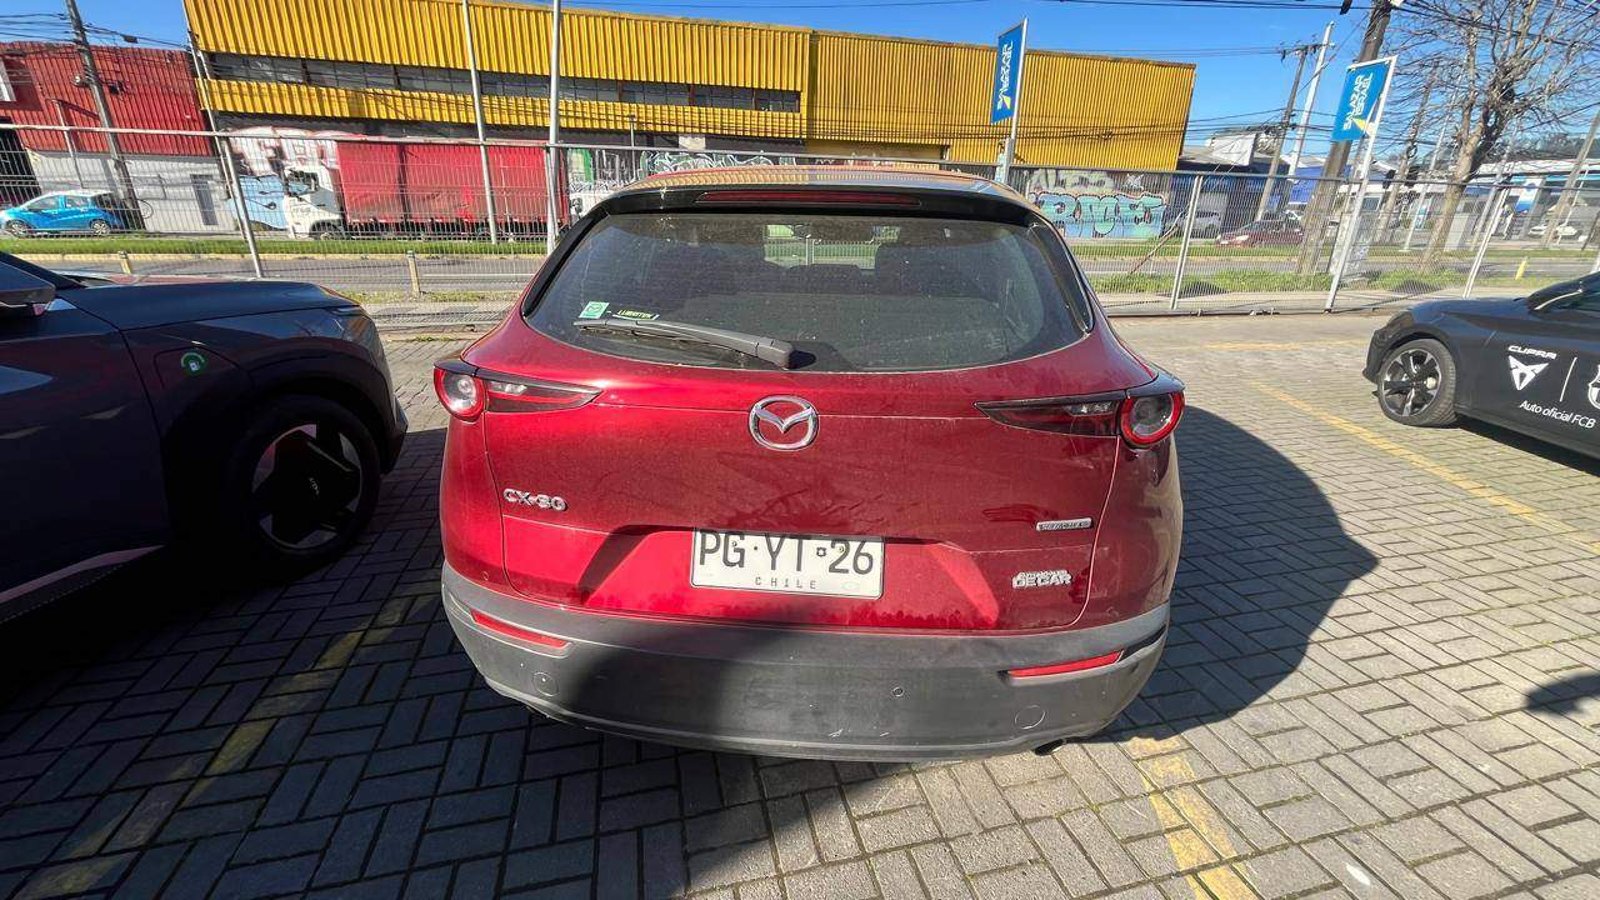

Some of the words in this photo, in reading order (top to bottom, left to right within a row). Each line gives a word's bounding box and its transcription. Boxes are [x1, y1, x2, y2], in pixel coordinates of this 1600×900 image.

[1519, 400, 1542, 414] Auto
[1542, 407, 1574, 422] oficial
[1571, 414, 1597, 429] FCB
[503, 488, 567, 511] CX-30
[755, 576, 817, 590] CHILE
